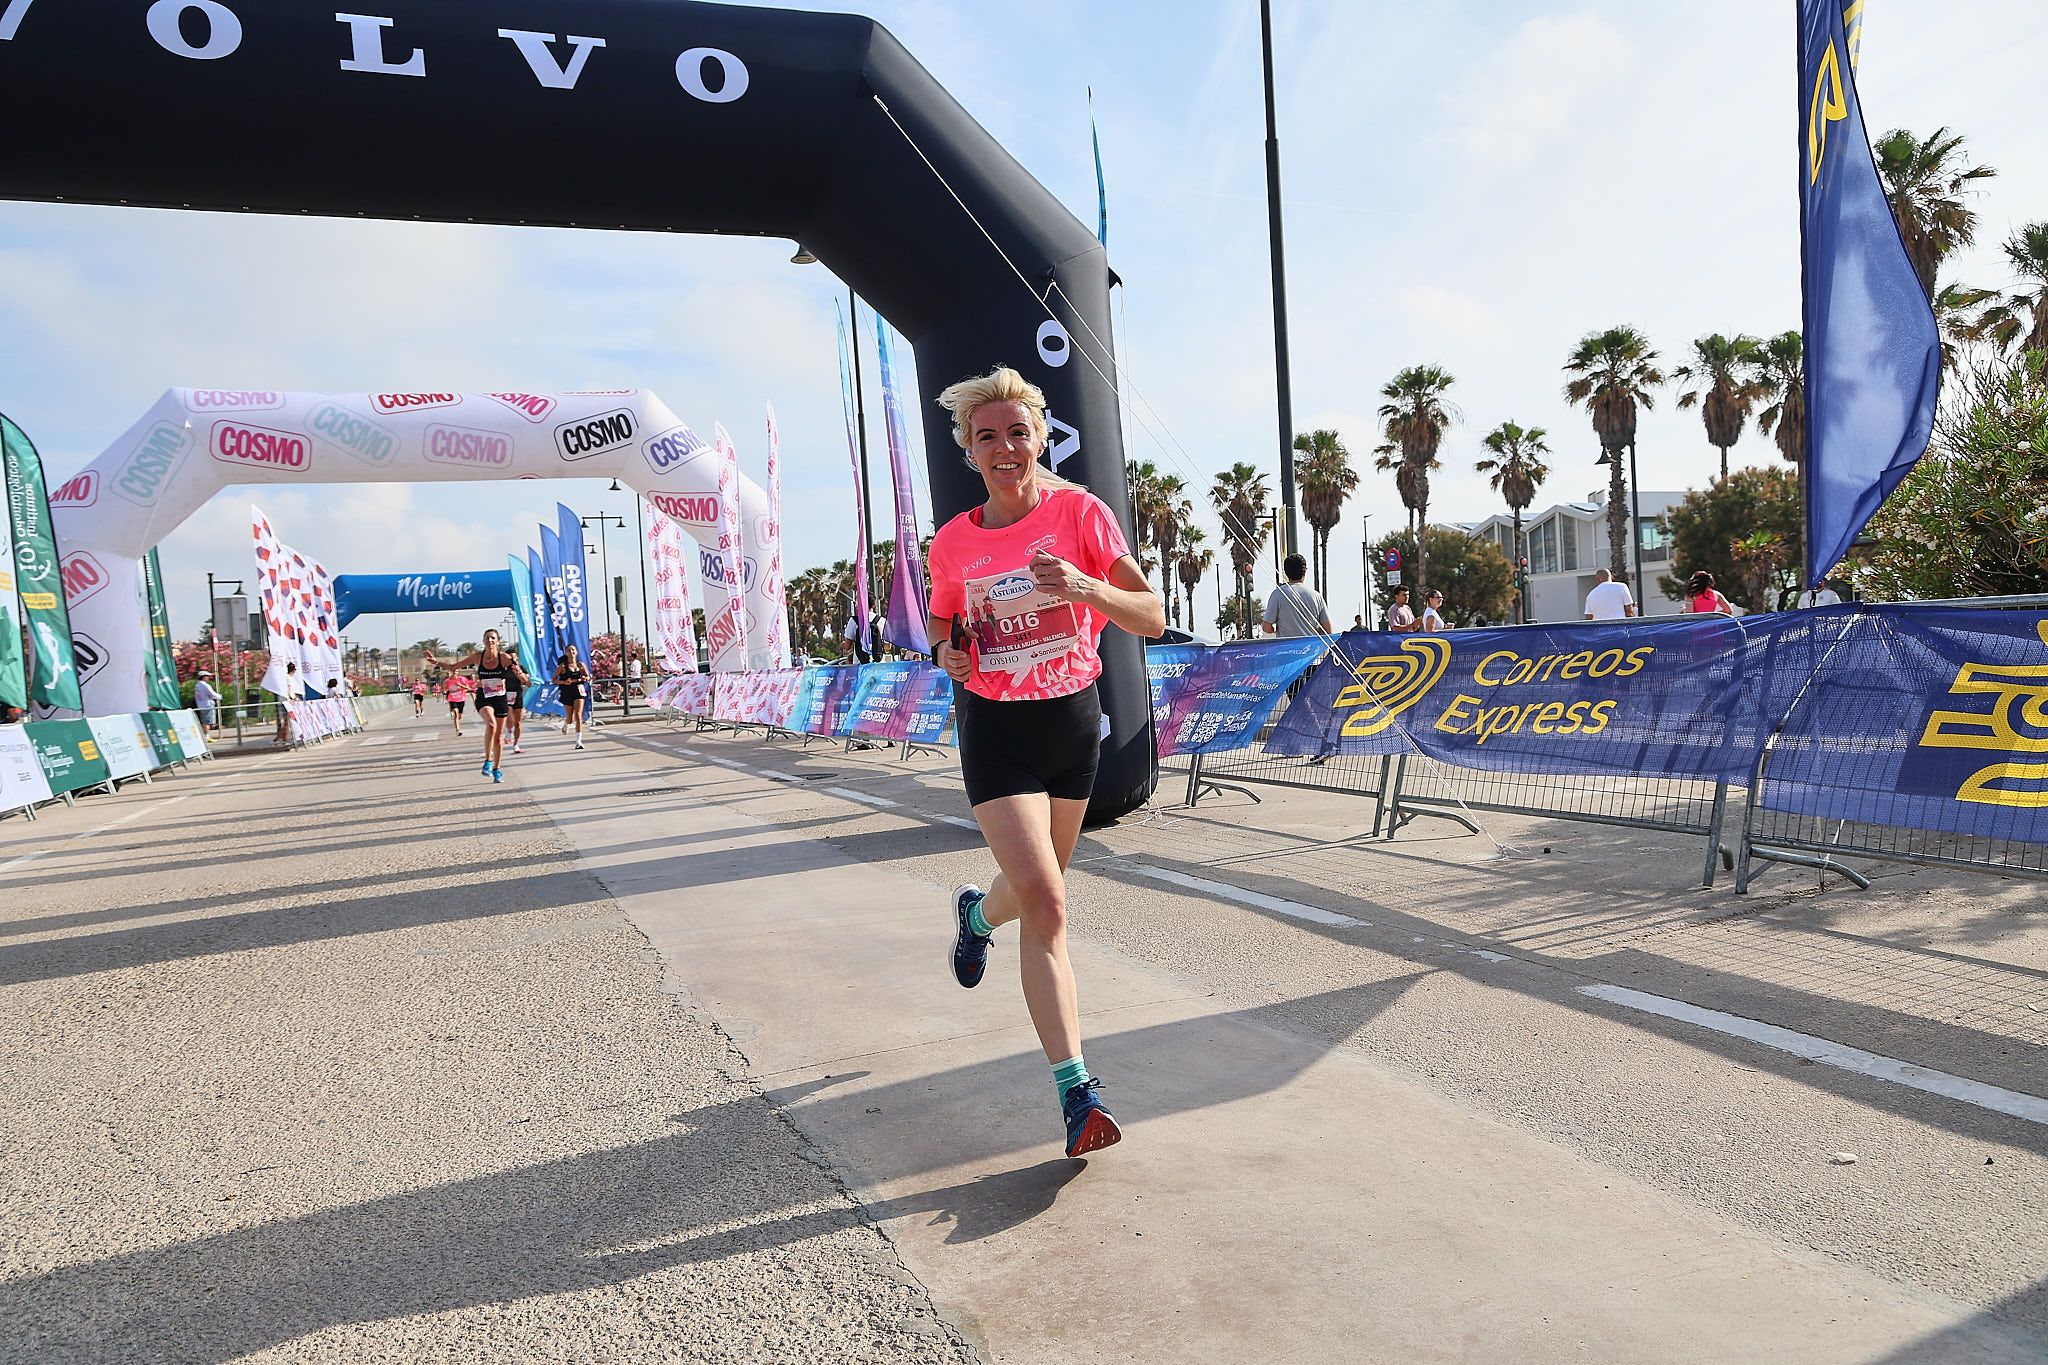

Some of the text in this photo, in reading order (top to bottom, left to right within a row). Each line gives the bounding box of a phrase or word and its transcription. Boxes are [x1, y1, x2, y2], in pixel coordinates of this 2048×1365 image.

[219, 426, 304, 467] COSMO
[313, 406, 393, 461] COSMO
[431, 428, 507, 465] COSMO
[562, 412, 633, 456] COSMO
[119, 427, 186, 499] COSMO
[653, 494, 719, 523] COSMO
[992, 584, 1032, 599] ASTURIANA
[999, 612, 1040, 635] 016
[989, 655, 1019, 666] OYSHO
[1039, 645, 1070, 657] Santander
[1474, 646, 1656, 688] Correos
[1433, 694, 1618, 745] Express
